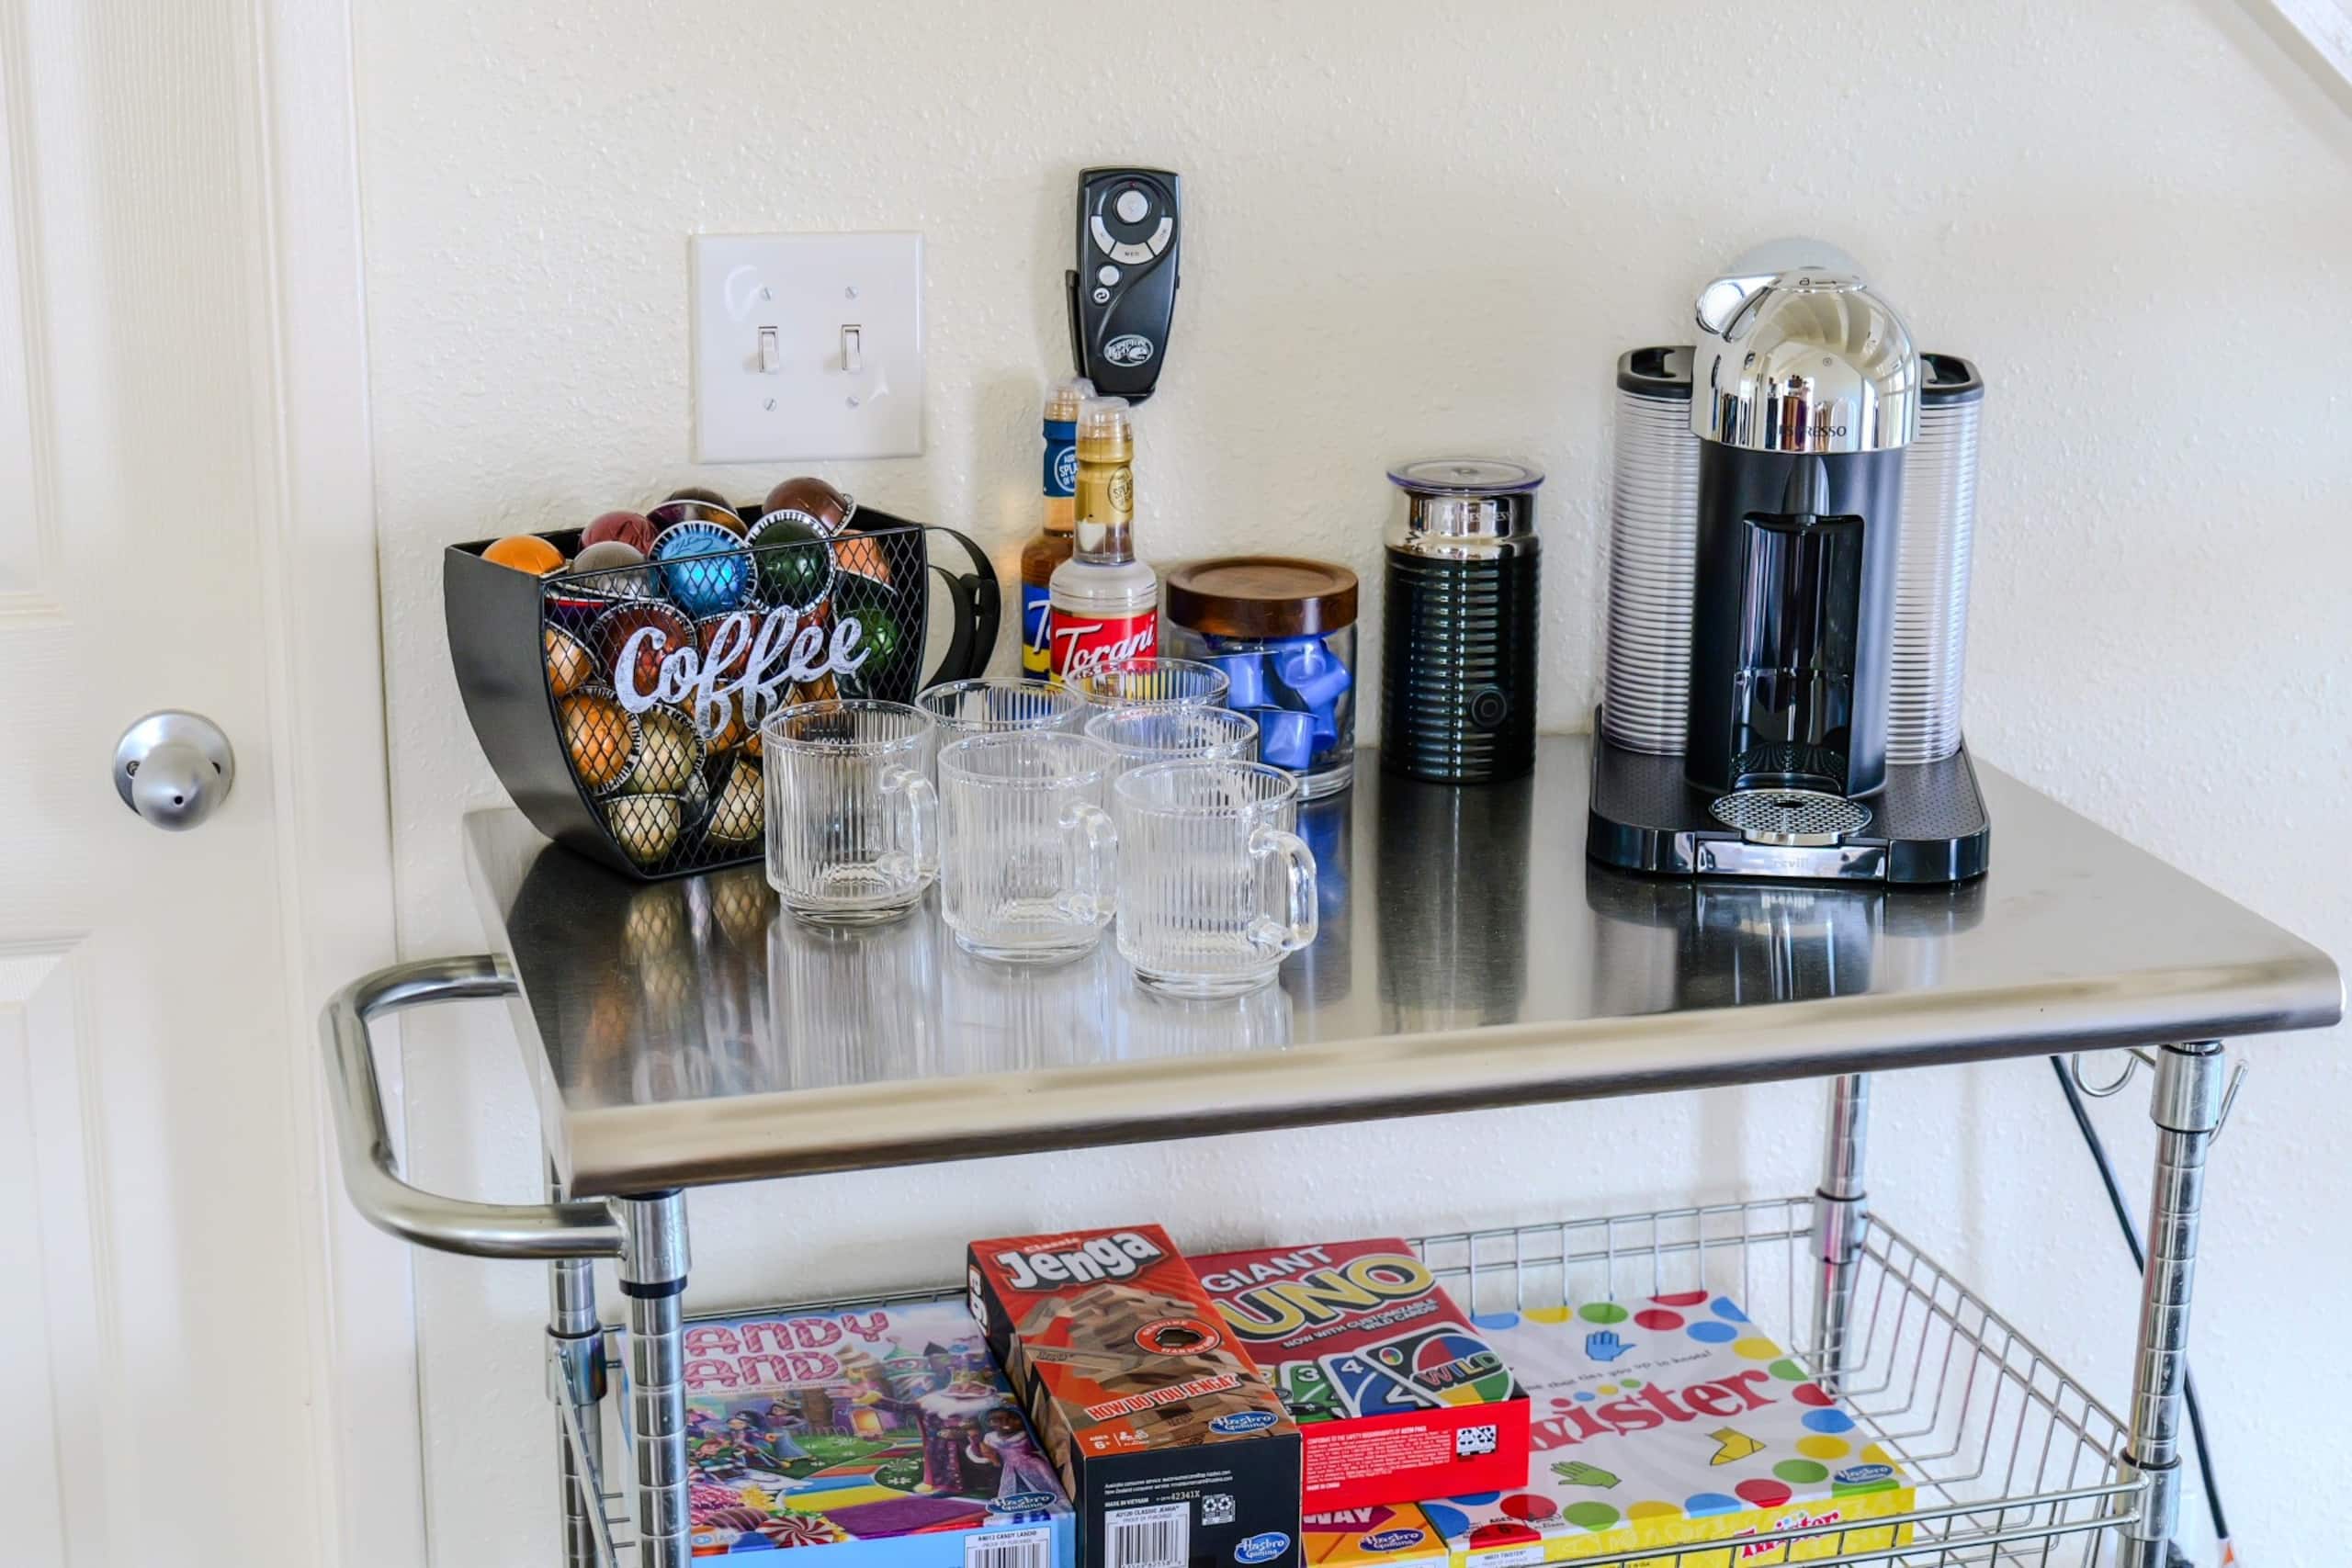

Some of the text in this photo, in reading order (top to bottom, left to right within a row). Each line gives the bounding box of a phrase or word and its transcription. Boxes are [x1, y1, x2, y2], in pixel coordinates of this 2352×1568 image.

[1056, 614, 1156, 682] Torani
[614, 604, 872, 740] Coffee
[996, 1232, 1162, 1289] Jenga
[1201, 1245, 1332, 1292] GIANT
[1212, 1253, 1435, 1337] UNO
[684, 1312, 889, 1357] ANDY
[684, 1351, 840, 1389] AND
[1297, 1366, 1320, 1382] 3
[1340, 1359, 1364, 1374] 4
[1415, 1350, 1505, 1389] WILD
[1087, 1400, 1129, 1420] HOW
[1127, 1393, 1154, 1411] DO
[1150, 1386, 1186, 1404] YOU
[1185, 1373, 1238, 1396] JENGA?
[1213, 1416, 1272, 1426] Hasbro
[992, 1495, 1050, 1507] Hasbro
[1238, 1539, 1285, 1551] Hasbro
[1366, 1532, 1419, 1545] Hasbro
